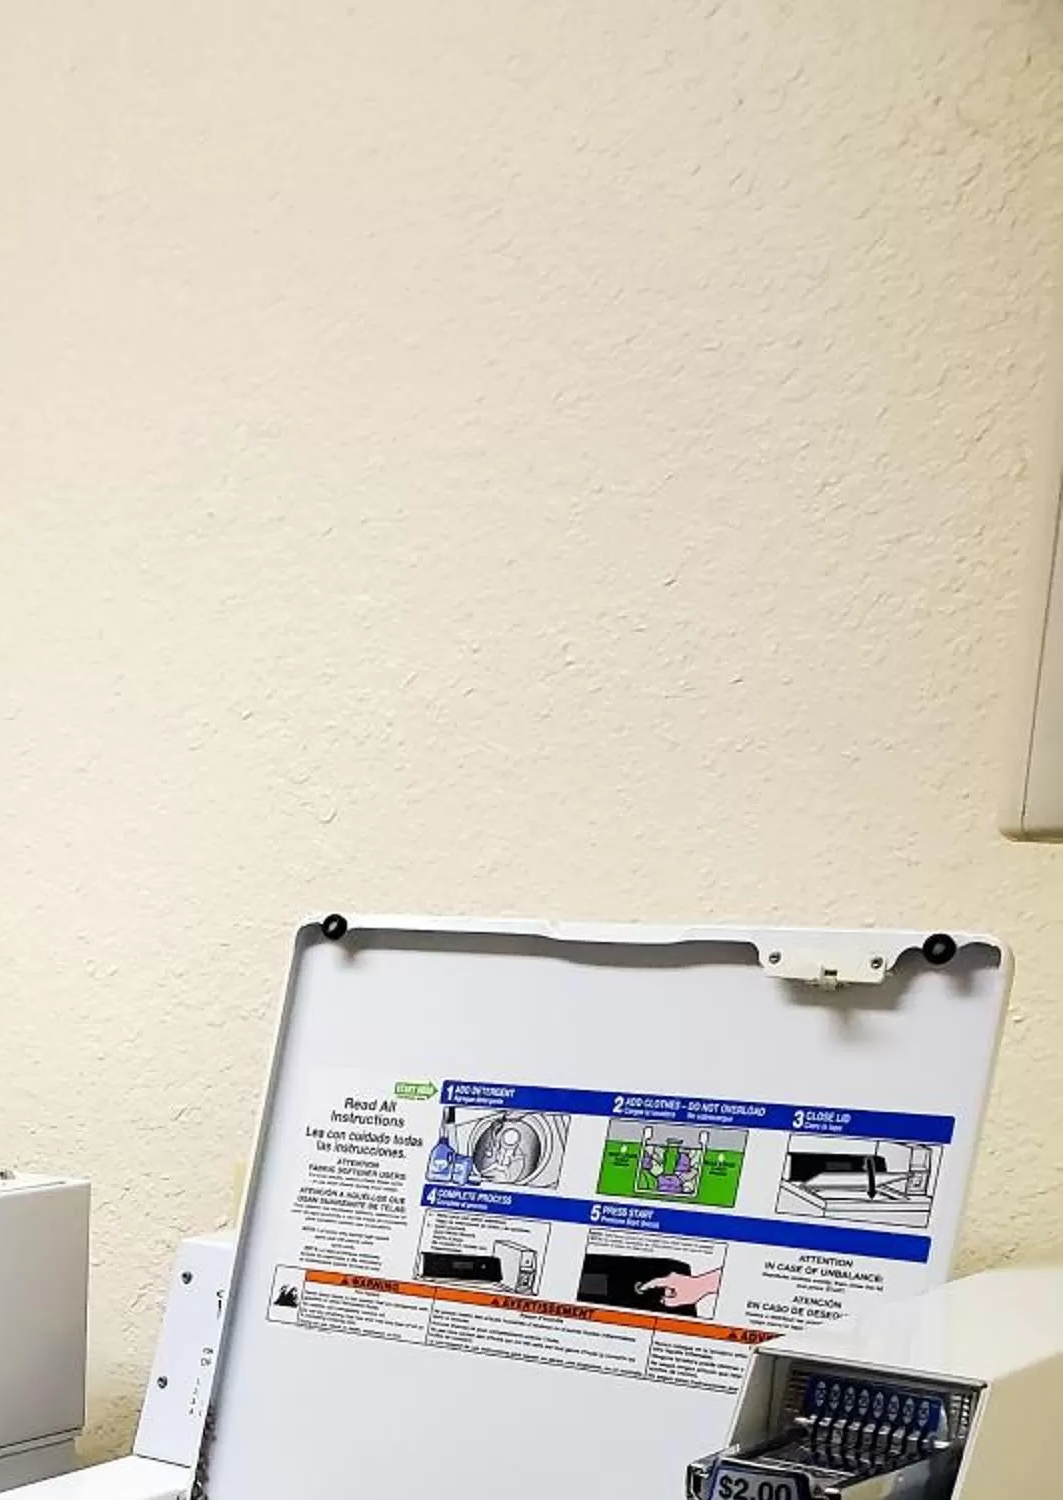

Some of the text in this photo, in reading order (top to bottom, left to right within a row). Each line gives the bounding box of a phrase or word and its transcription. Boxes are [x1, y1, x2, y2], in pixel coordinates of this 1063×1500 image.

[446, 1084, 455, 1101] 1
[344, 1097, 398, 1113] Read All
[612, 1095, 625, 1113] 2
[700, 1103, 718, 1113] NOT
[330, 1110, 406, 1128] Instructions
[792, 1109, 805, 1129] 3
[326, 1130, 346, 1141] con
[348, 1131, 391, 1145] cuidado
[426, 1188, 437, 1205] 4
[590, 1203, 602, 1221] 5
[602, 1205, 628, 1217] PRESS
[764, 1261, 775, 1270] IN
[777, 1263, 803, 1273] CASE
[805, 1267, 817, 1275] OF
[799, 1255, 854, 1268] ATTENTION
[746, 1301, 760, 1310] EN
